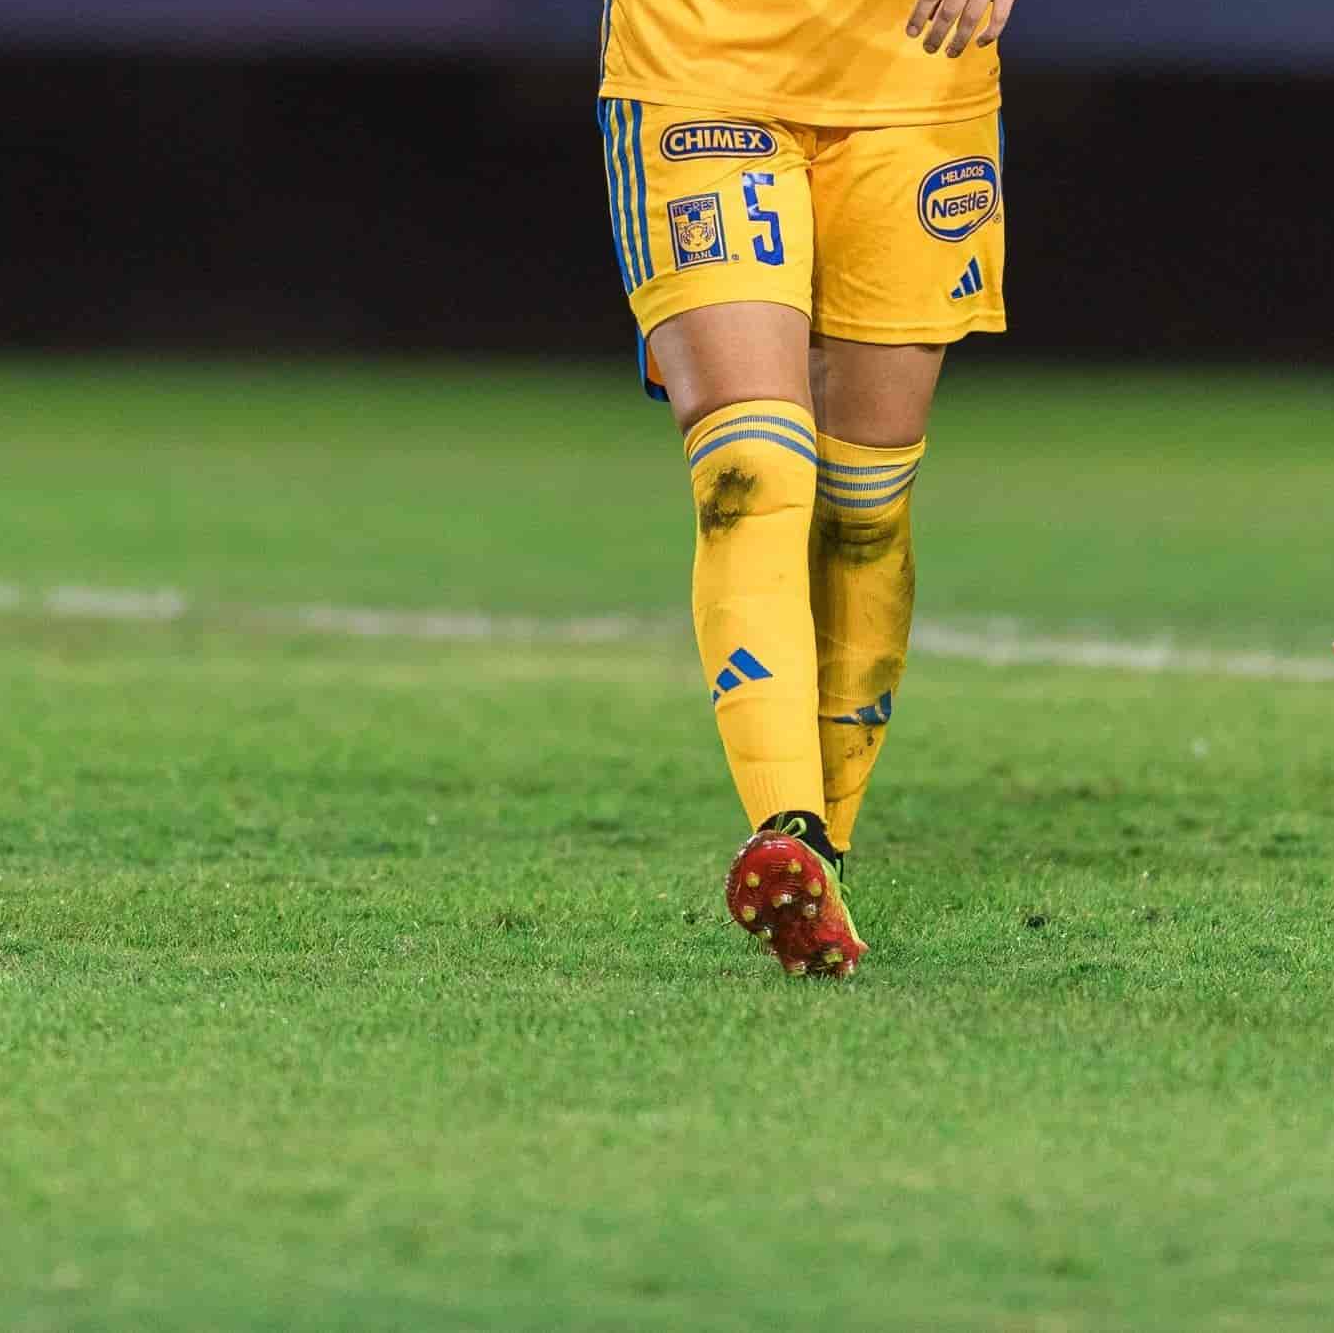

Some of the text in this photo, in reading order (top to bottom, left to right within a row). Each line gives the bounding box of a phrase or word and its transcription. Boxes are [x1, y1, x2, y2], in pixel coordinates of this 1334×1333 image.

[669, 129, 766, 152] CHIMEX
[940, 165, 985, 185] HELADOS
[671, 199, 715, 216] TIGRES
[930, 189, 989, 219] Nestlé
[742, 172, 785, 266] 5
